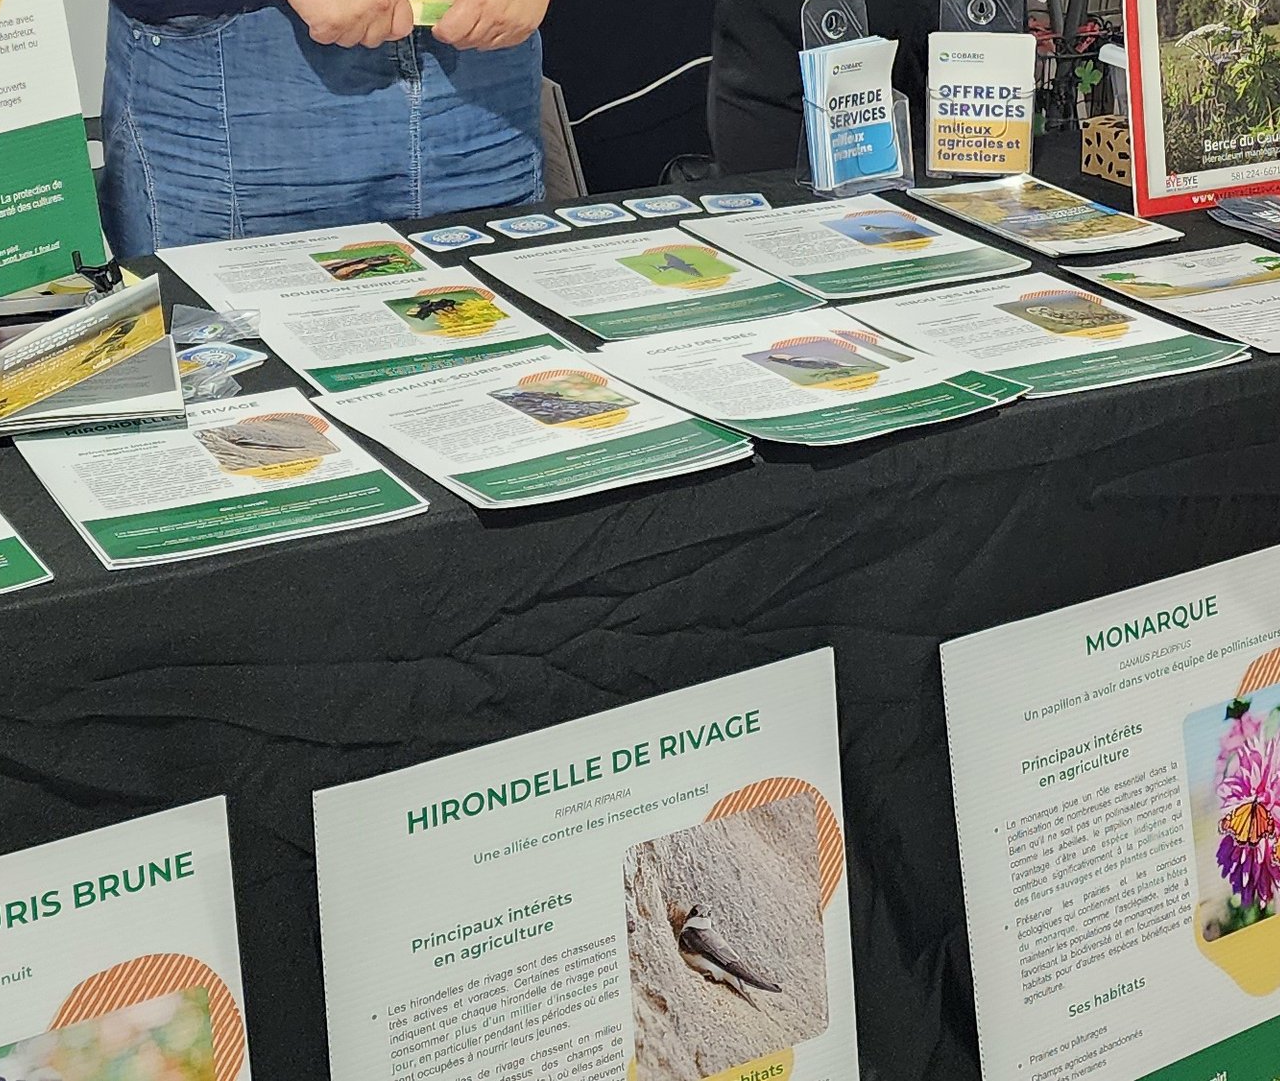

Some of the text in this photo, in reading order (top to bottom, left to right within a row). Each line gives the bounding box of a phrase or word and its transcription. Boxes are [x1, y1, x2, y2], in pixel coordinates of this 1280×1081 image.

[828, 88, 881, 111] OFFRE DE
[939, 84, 1023, 101] OFFRE DE
[830, 106, 886, 129] SERVICES
[938, 102, 1024, 118] SERVICES
[938, 135, 1020, 150] agricoles et
[1204, 138, 1237, 152] Berce
[1239, 134, 1254, 147] du
[937, 150, 1005, 162] forestiers
[1086, 595, 1218, 655] MONARQUE
[1023, 710, 1038, 721] Un
[1041, 695, 1081, 718] papillon
[1083, 691, 1090, 701] à
[1092, 682, 1116, 698] avoir
[1118, 675, 1142, 689] dans
[1144, 666, 1169, 680] votre
[1171, 655, 1204, 671] équipe
[1206, 649, 1218, 660] de
[407, 709, 760, 834] HIRONDELLE DE RIVAGE
[473, 783, 708, 864] Une alliée contre les insectes volants!
[73, 851, 194, 908] BRUNE
[412, 893, 572, 953] Principaux intérêts
[434, 921, 553, 967] en agriculture
[1, 966, 32, 985] nuit
